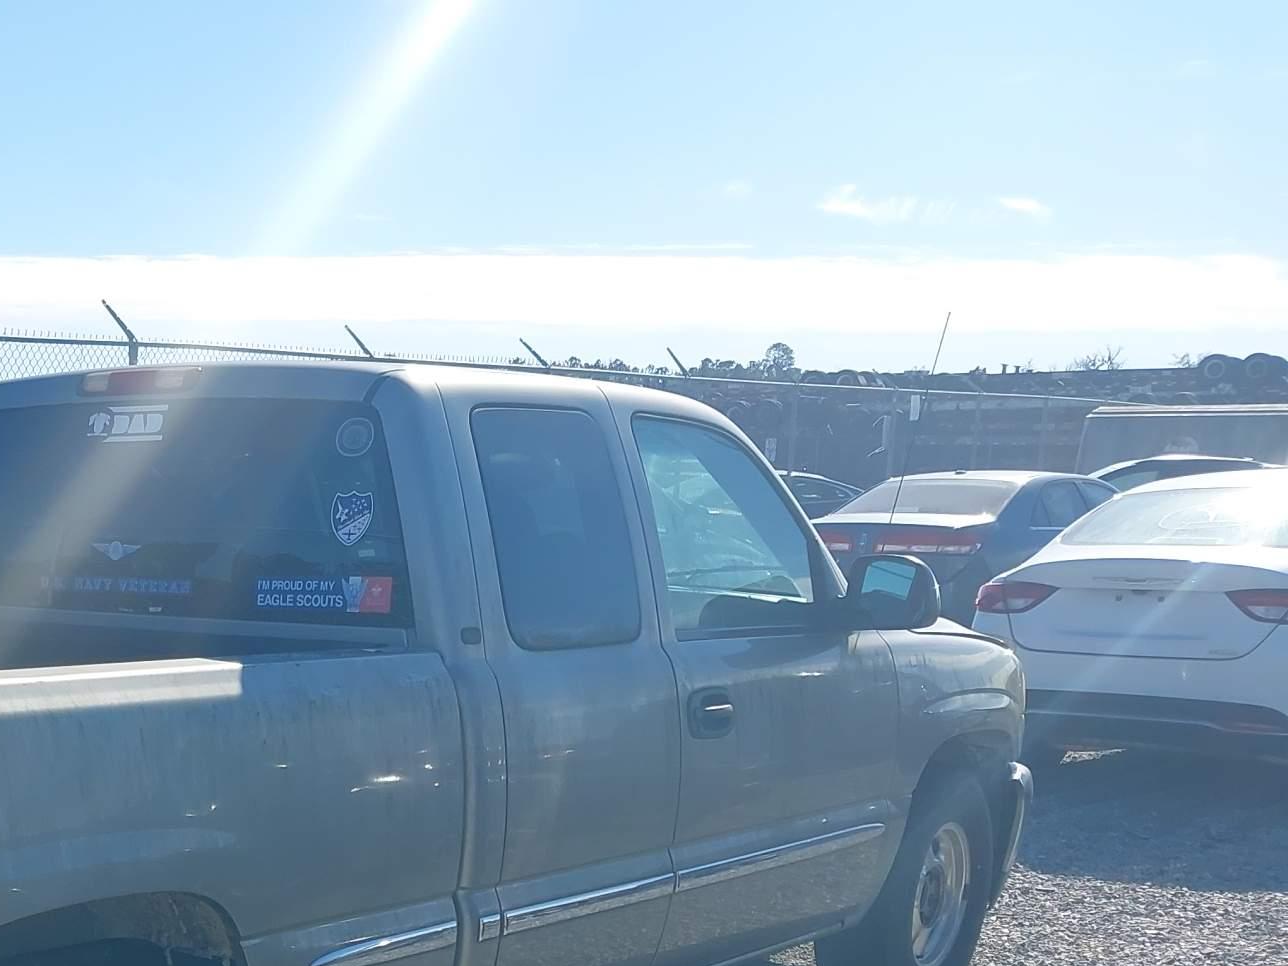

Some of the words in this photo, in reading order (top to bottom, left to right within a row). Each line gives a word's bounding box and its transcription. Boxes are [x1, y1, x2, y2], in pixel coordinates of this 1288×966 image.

[257, 580, 270, 590] I'M
[272, 580, 303, 591] PROUD
[305, 580, 318, 591] OF
[320, 580, 335, 591] MY
[257, 594, 294, 606] EAGLE
[296, 594, 344, 608] SCOUTS
